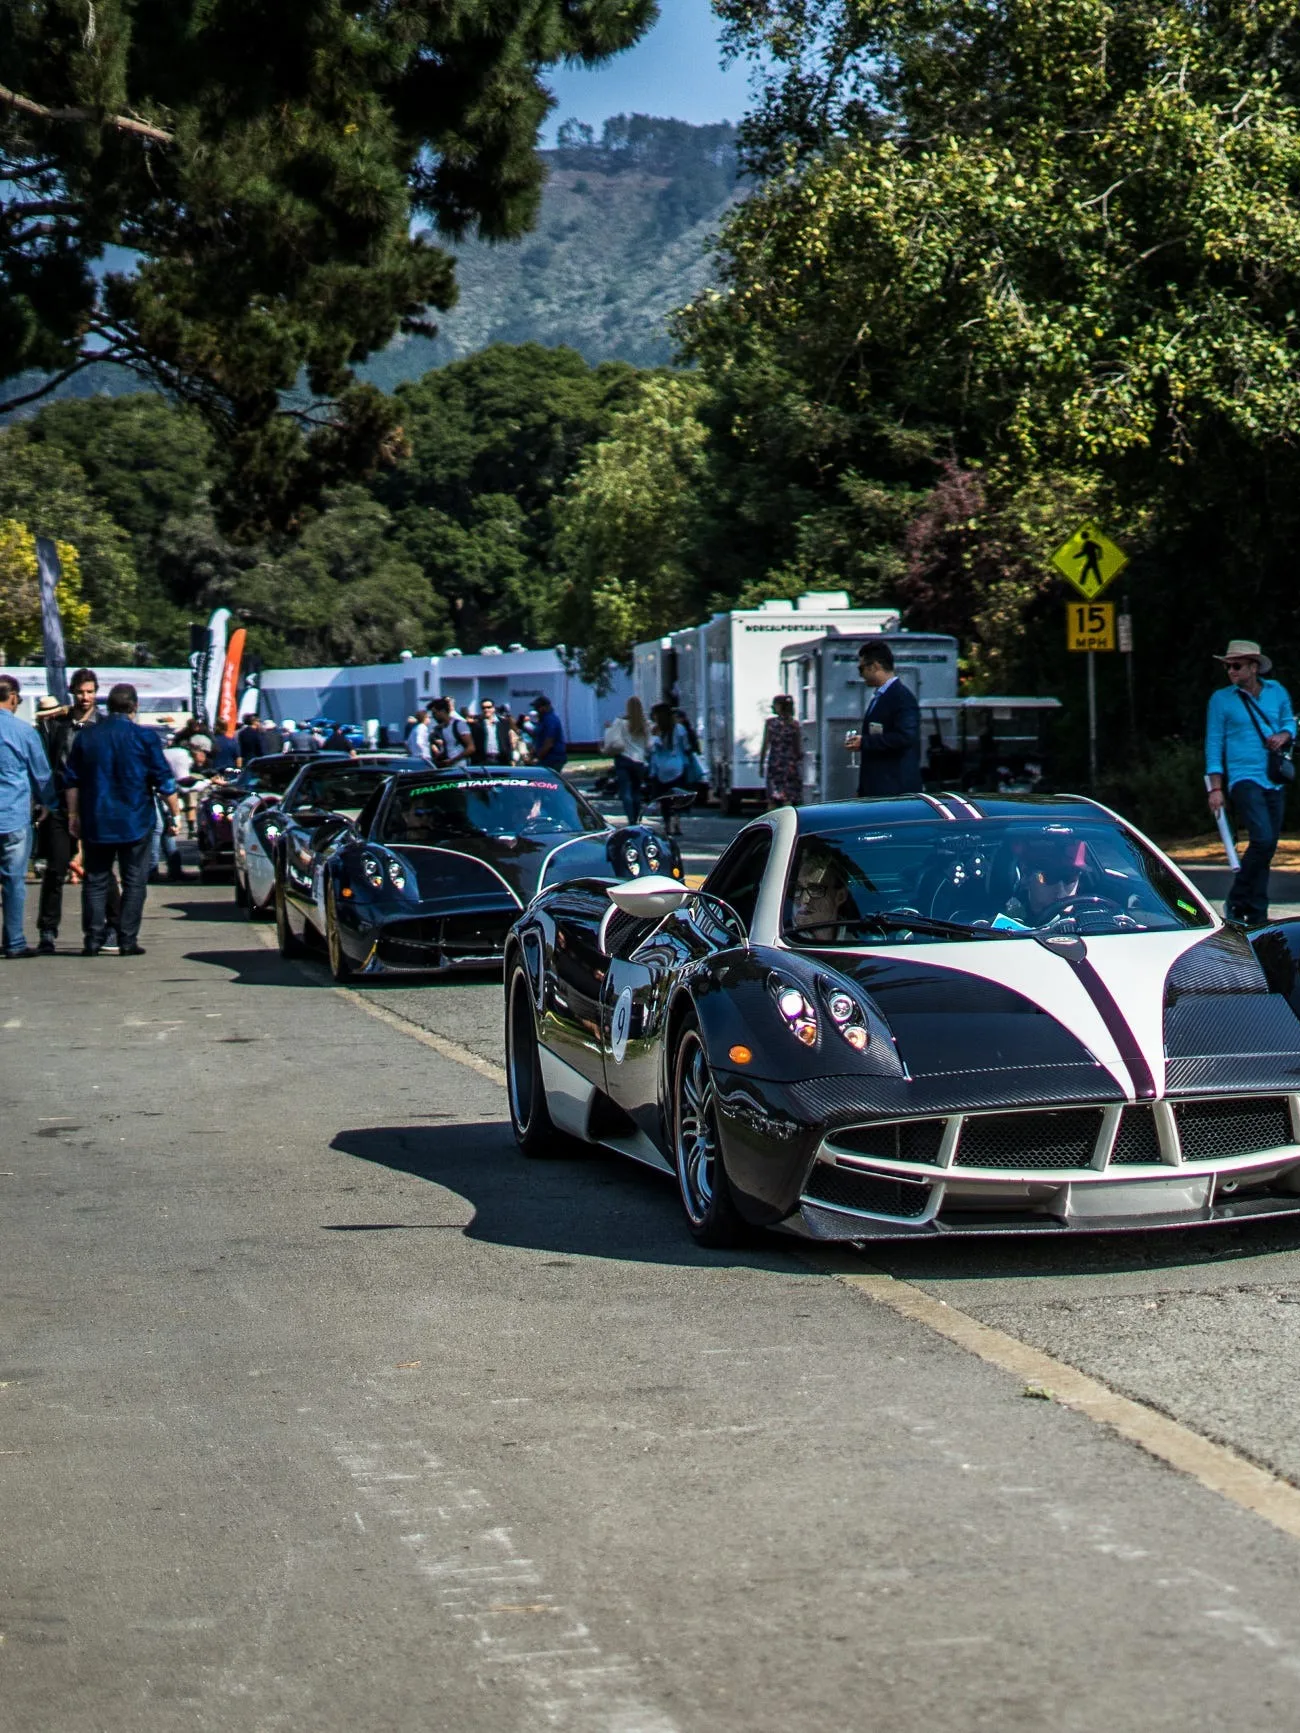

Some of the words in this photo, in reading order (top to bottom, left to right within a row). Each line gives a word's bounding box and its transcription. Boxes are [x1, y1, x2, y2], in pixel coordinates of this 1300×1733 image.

[1076, 607, 1105, 633] 15
[1076, 637, 1107, 649] MPH
[617, 1007, 625, 1045] 9
